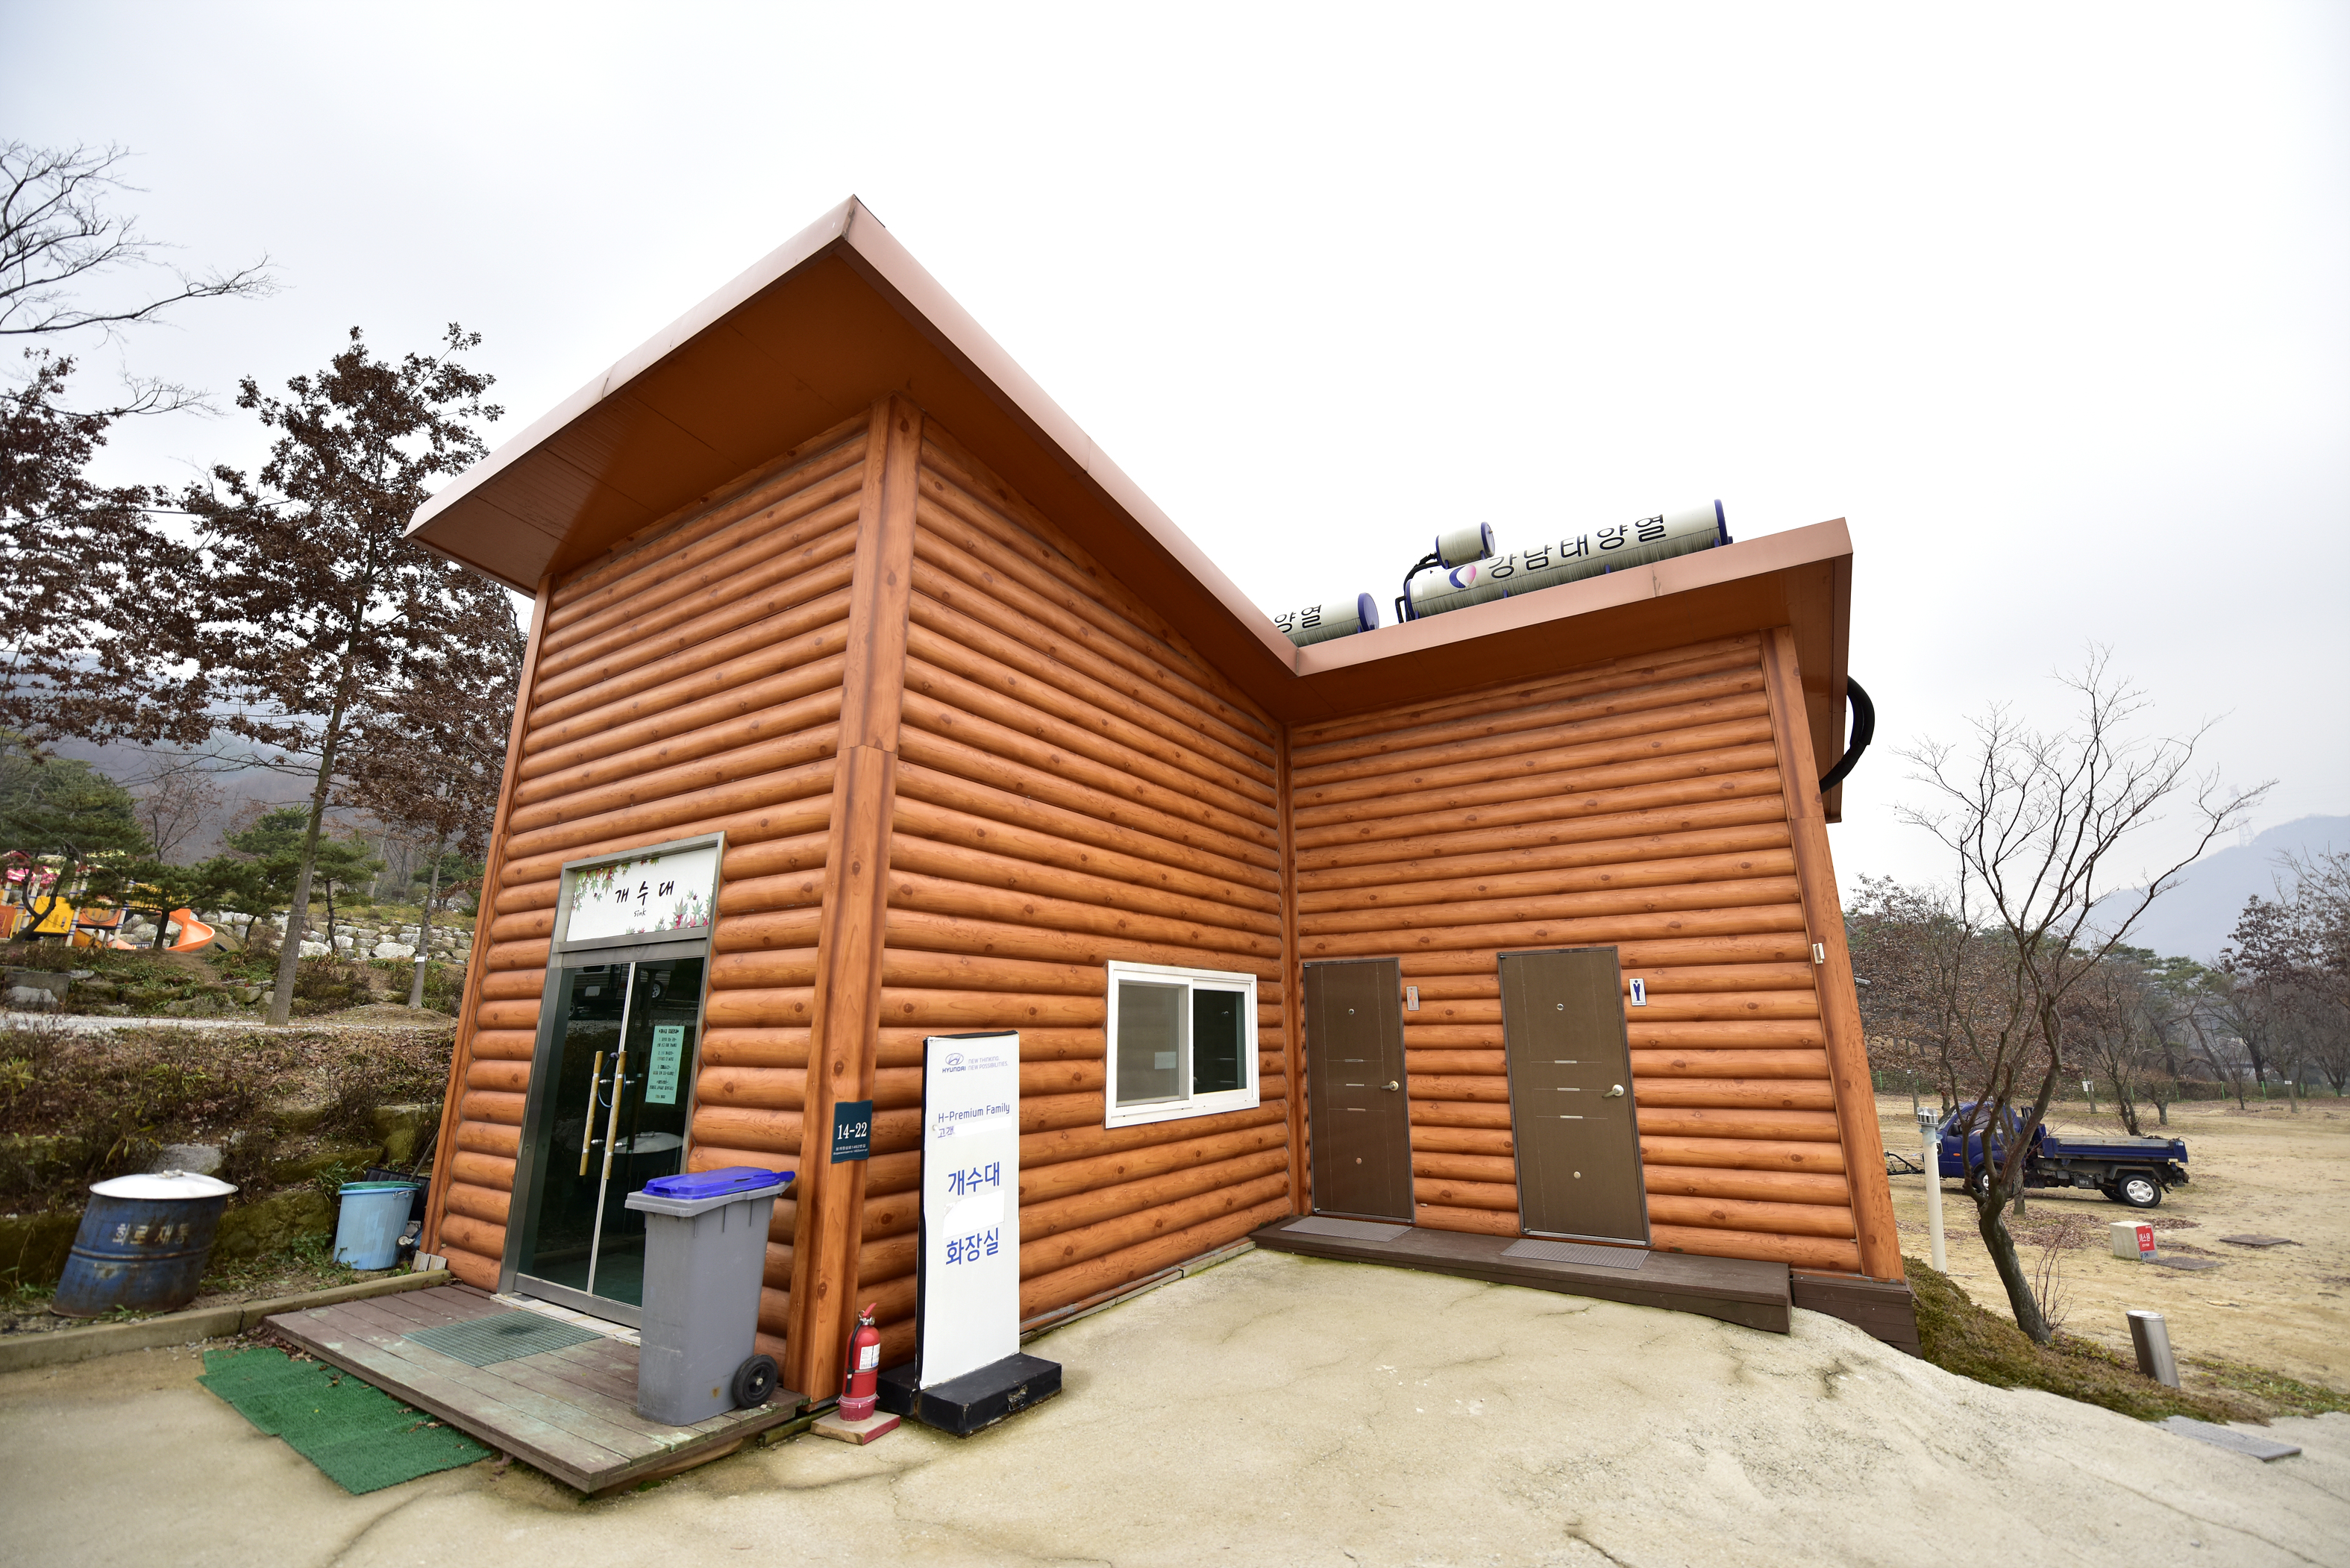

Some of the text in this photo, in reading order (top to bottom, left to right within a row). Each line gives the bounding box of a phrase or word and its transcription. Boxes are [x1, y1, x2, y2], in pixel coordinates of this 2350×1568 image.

[1488, 514, 1667, 579] 강남태양열
[615, 880, 674, 906] 개수대
[633, 909, 647, 918] sink
[941, 1065, 967, 1073] HYUNDAI
[938, 1103, 1010, 1123] H-Premium Family
[837, 1122, 868, 1140] 14-22
[948, 1161, 1000, 1196] 개수대
[946, 1227, 999, 1265] 화장실
